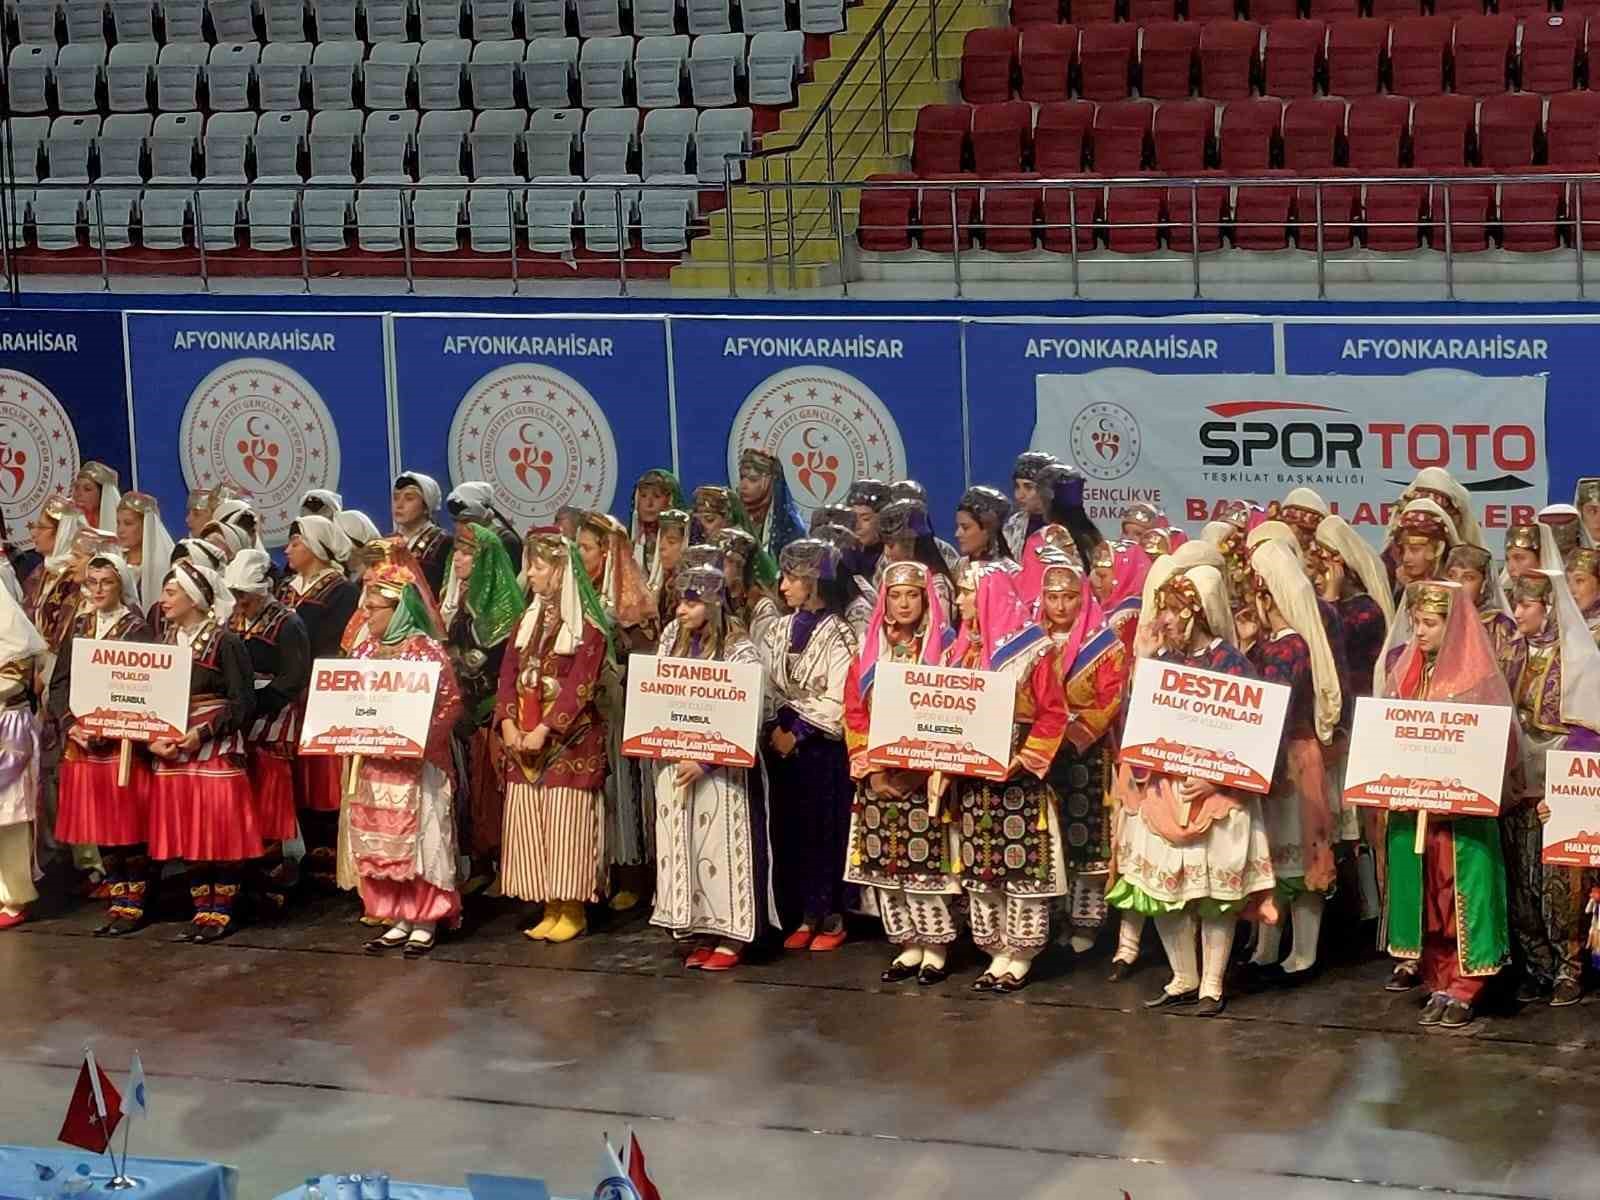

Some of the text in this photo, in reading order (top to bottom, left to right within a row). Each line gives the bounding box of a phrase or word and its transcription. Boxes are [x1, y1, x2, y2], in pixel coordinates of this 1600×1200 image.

[0, 328, 78, 352] RAHİSAR
[174, 330, 336, 352] AFYONKARAHİSAR
[443, 332, 613, 356] AFYONKARAHİSAR
[723, 334, 904, 359] AFYONKARAHİSAR
[1024, 335, 1219, 360] AFYONKARAHİSAR
[1341, 335, 1549, 360] AFYONKARAHİSAR
[91, 649, 172, 670] ANADOLU
[656, 659, 732, 683] İSTANBUL
[316, 670, 431, 693] BERGAMA
[1160, 669, 1264, 709] DESTAN
[909, 690, 977, 715] ÇAĞDAŞ
[1385, 707, 1436, 724] KONYA
[1395, 725, 1465, 743] BELEDİYE
